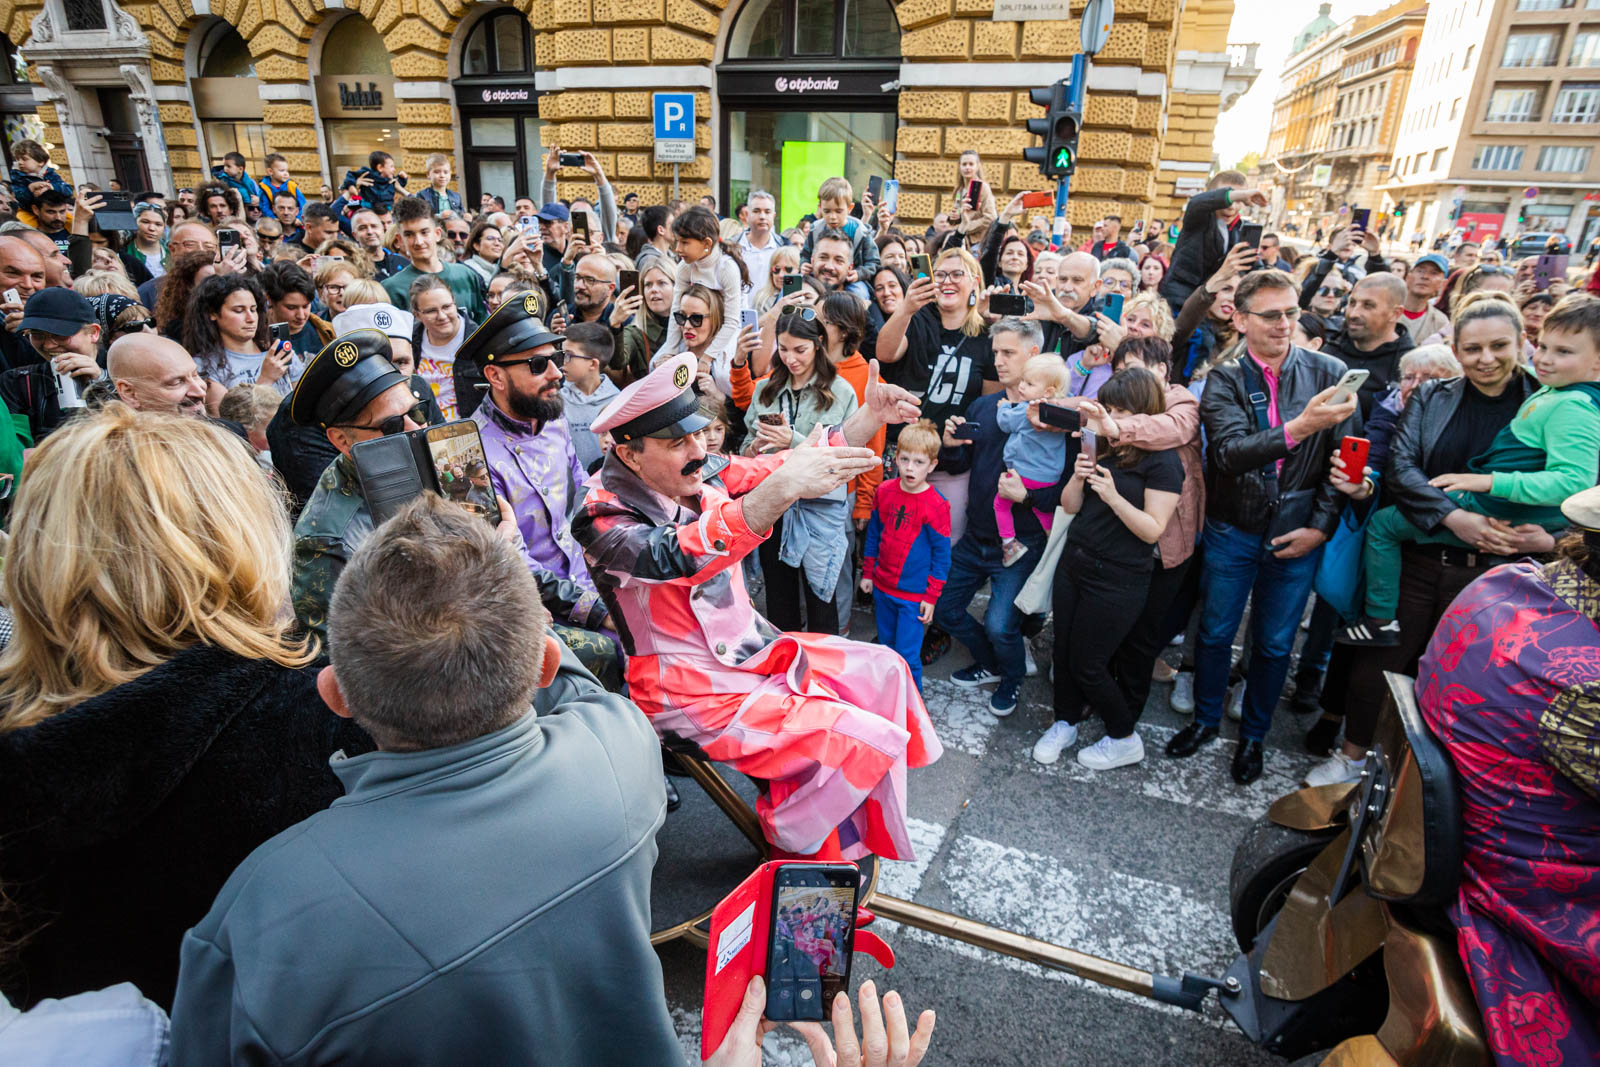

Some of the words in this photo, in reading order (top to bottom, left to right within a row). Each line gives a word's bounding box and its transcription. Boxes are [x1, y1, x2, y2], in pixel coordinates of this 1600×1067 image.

[789, 77, 839, 93] otpbanka
[492, 89, 529, 103] otpbanka
[664, 102, 685, 131] P
